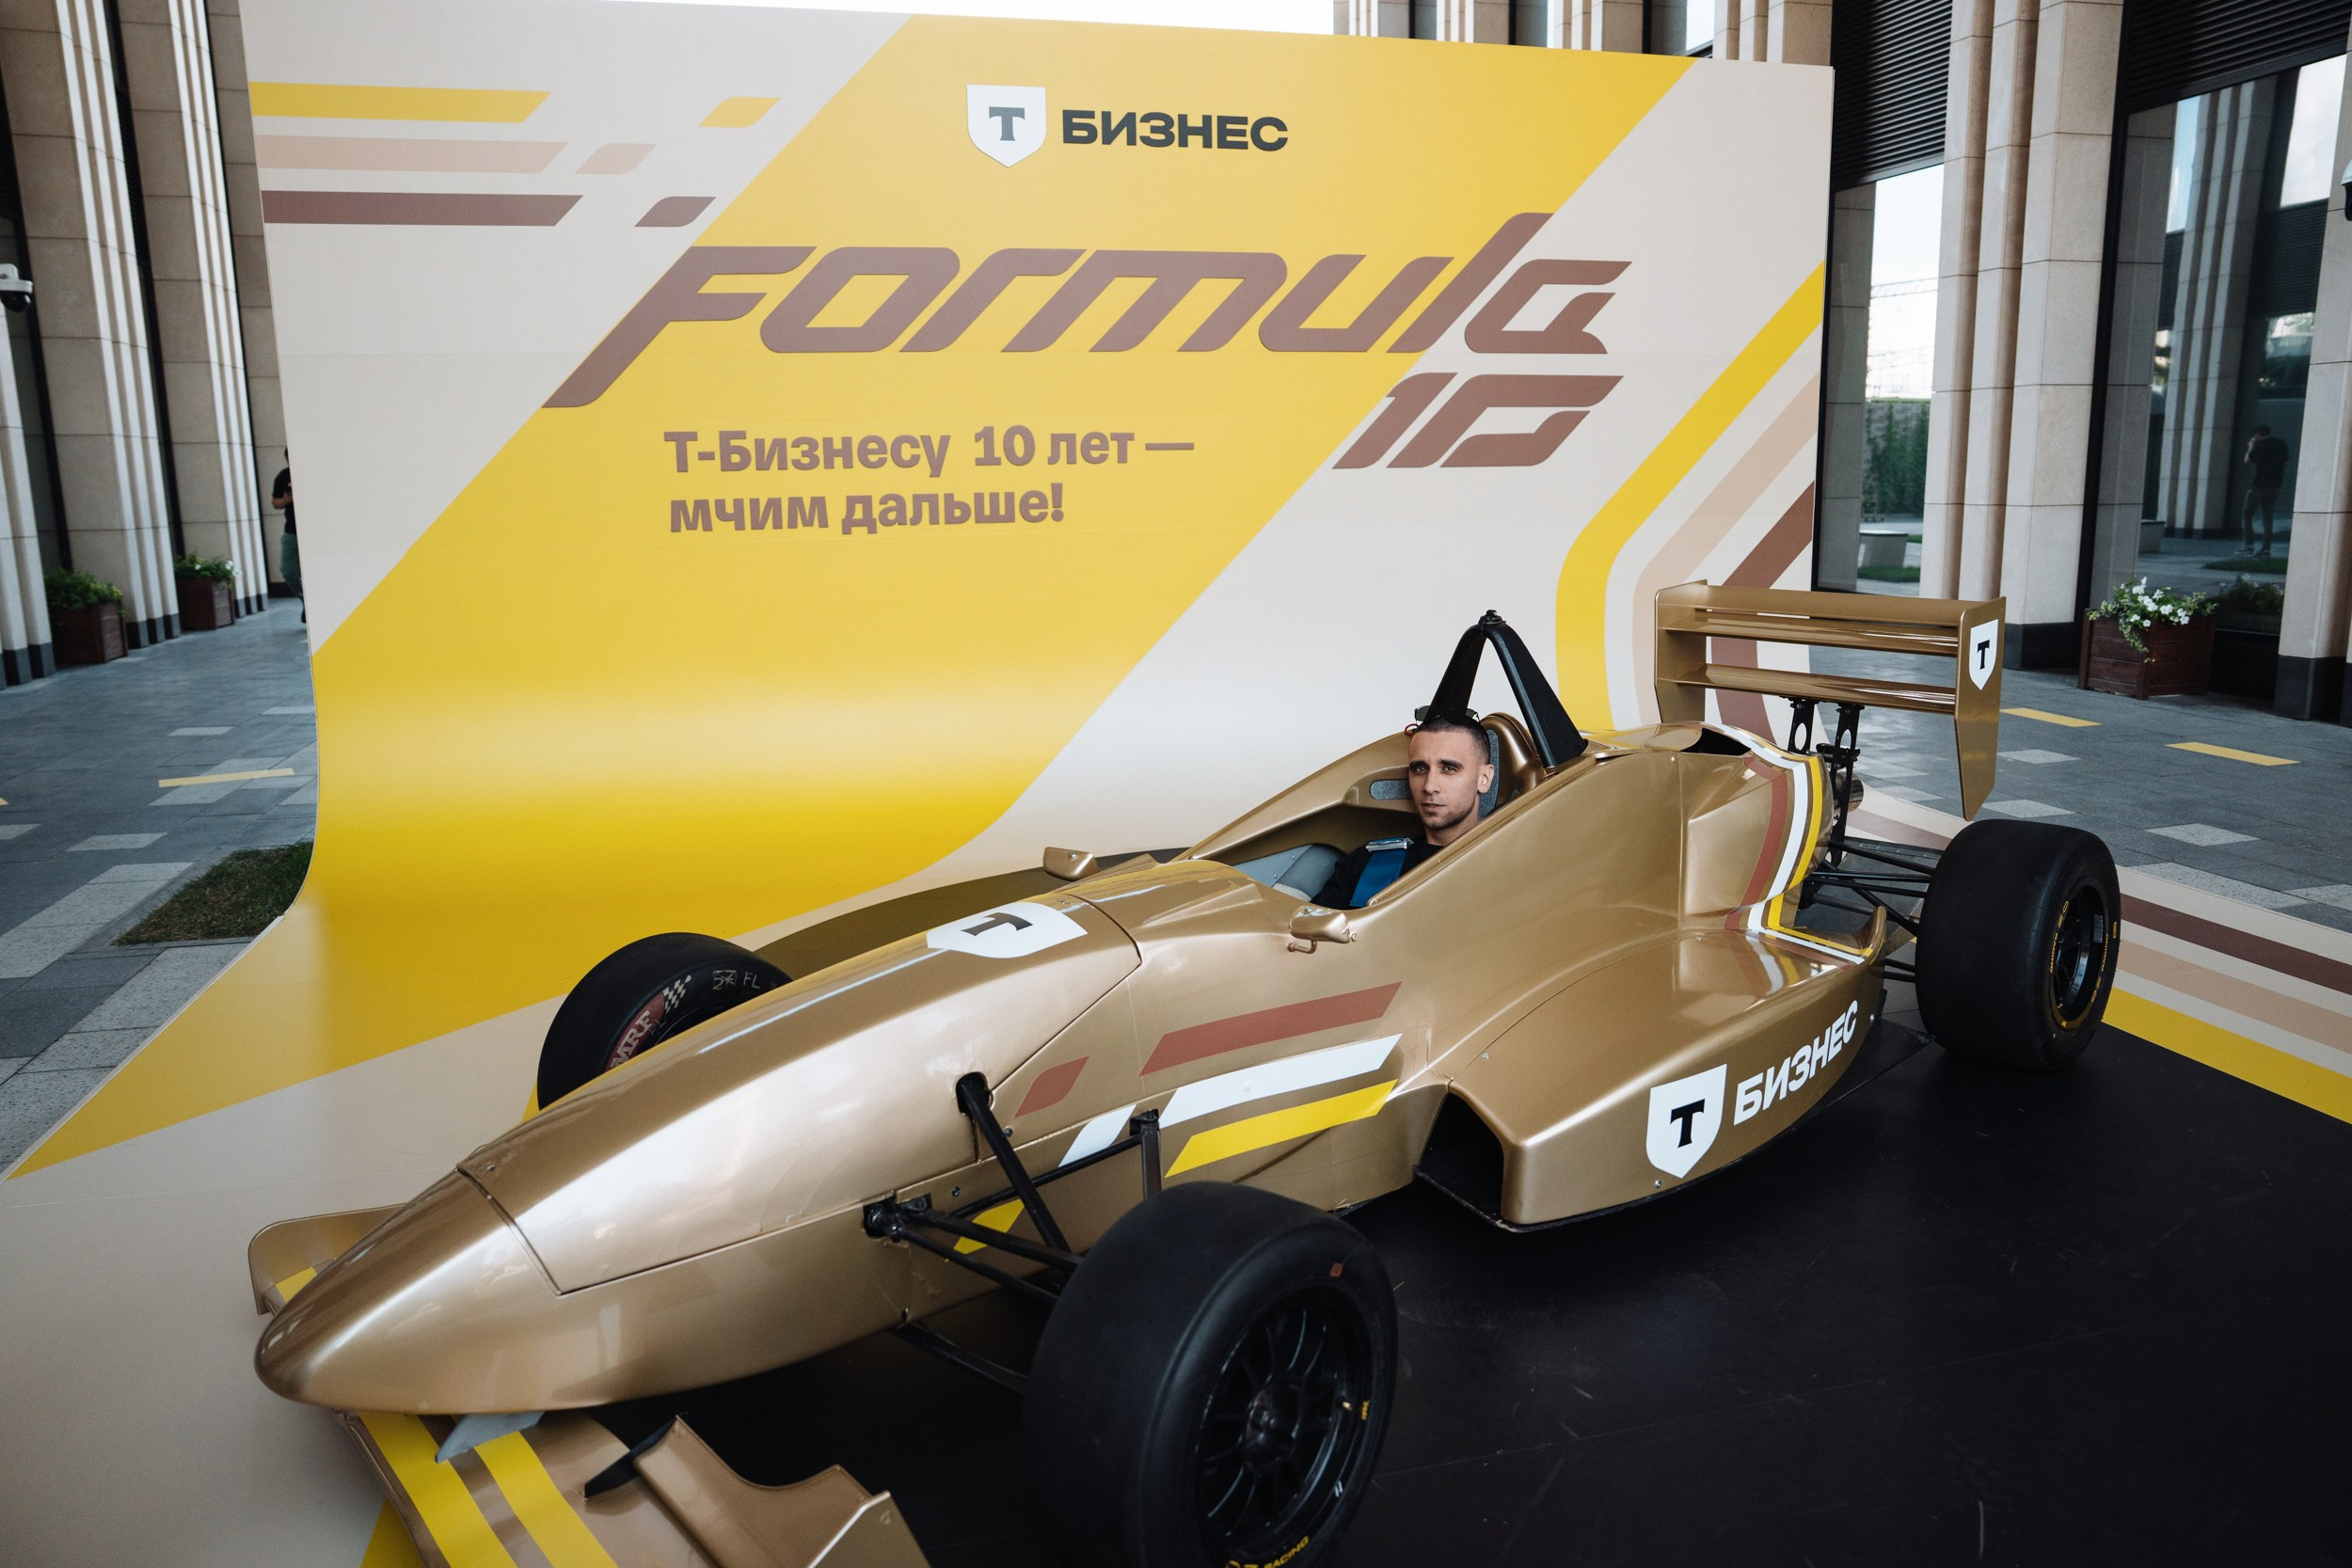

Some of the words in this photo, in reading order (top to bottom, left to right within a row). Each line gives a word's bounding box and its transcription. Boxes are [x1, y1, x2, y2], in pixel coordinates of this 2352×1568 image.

[1062, 109, 1289, 151] БИЗНЕС
[541, 213, 1632, 407] Formula
[663, 429, 952, 478] Т-Бизнесу
[974, 425, 1036, 467] 10
[1047, 431, 1136, 465] лет
[669, 496, 829, 533] мчим
[841, 483, 1065, 534] дальше!
[1733, 999, 1859, 1126] БИЗНЕС
